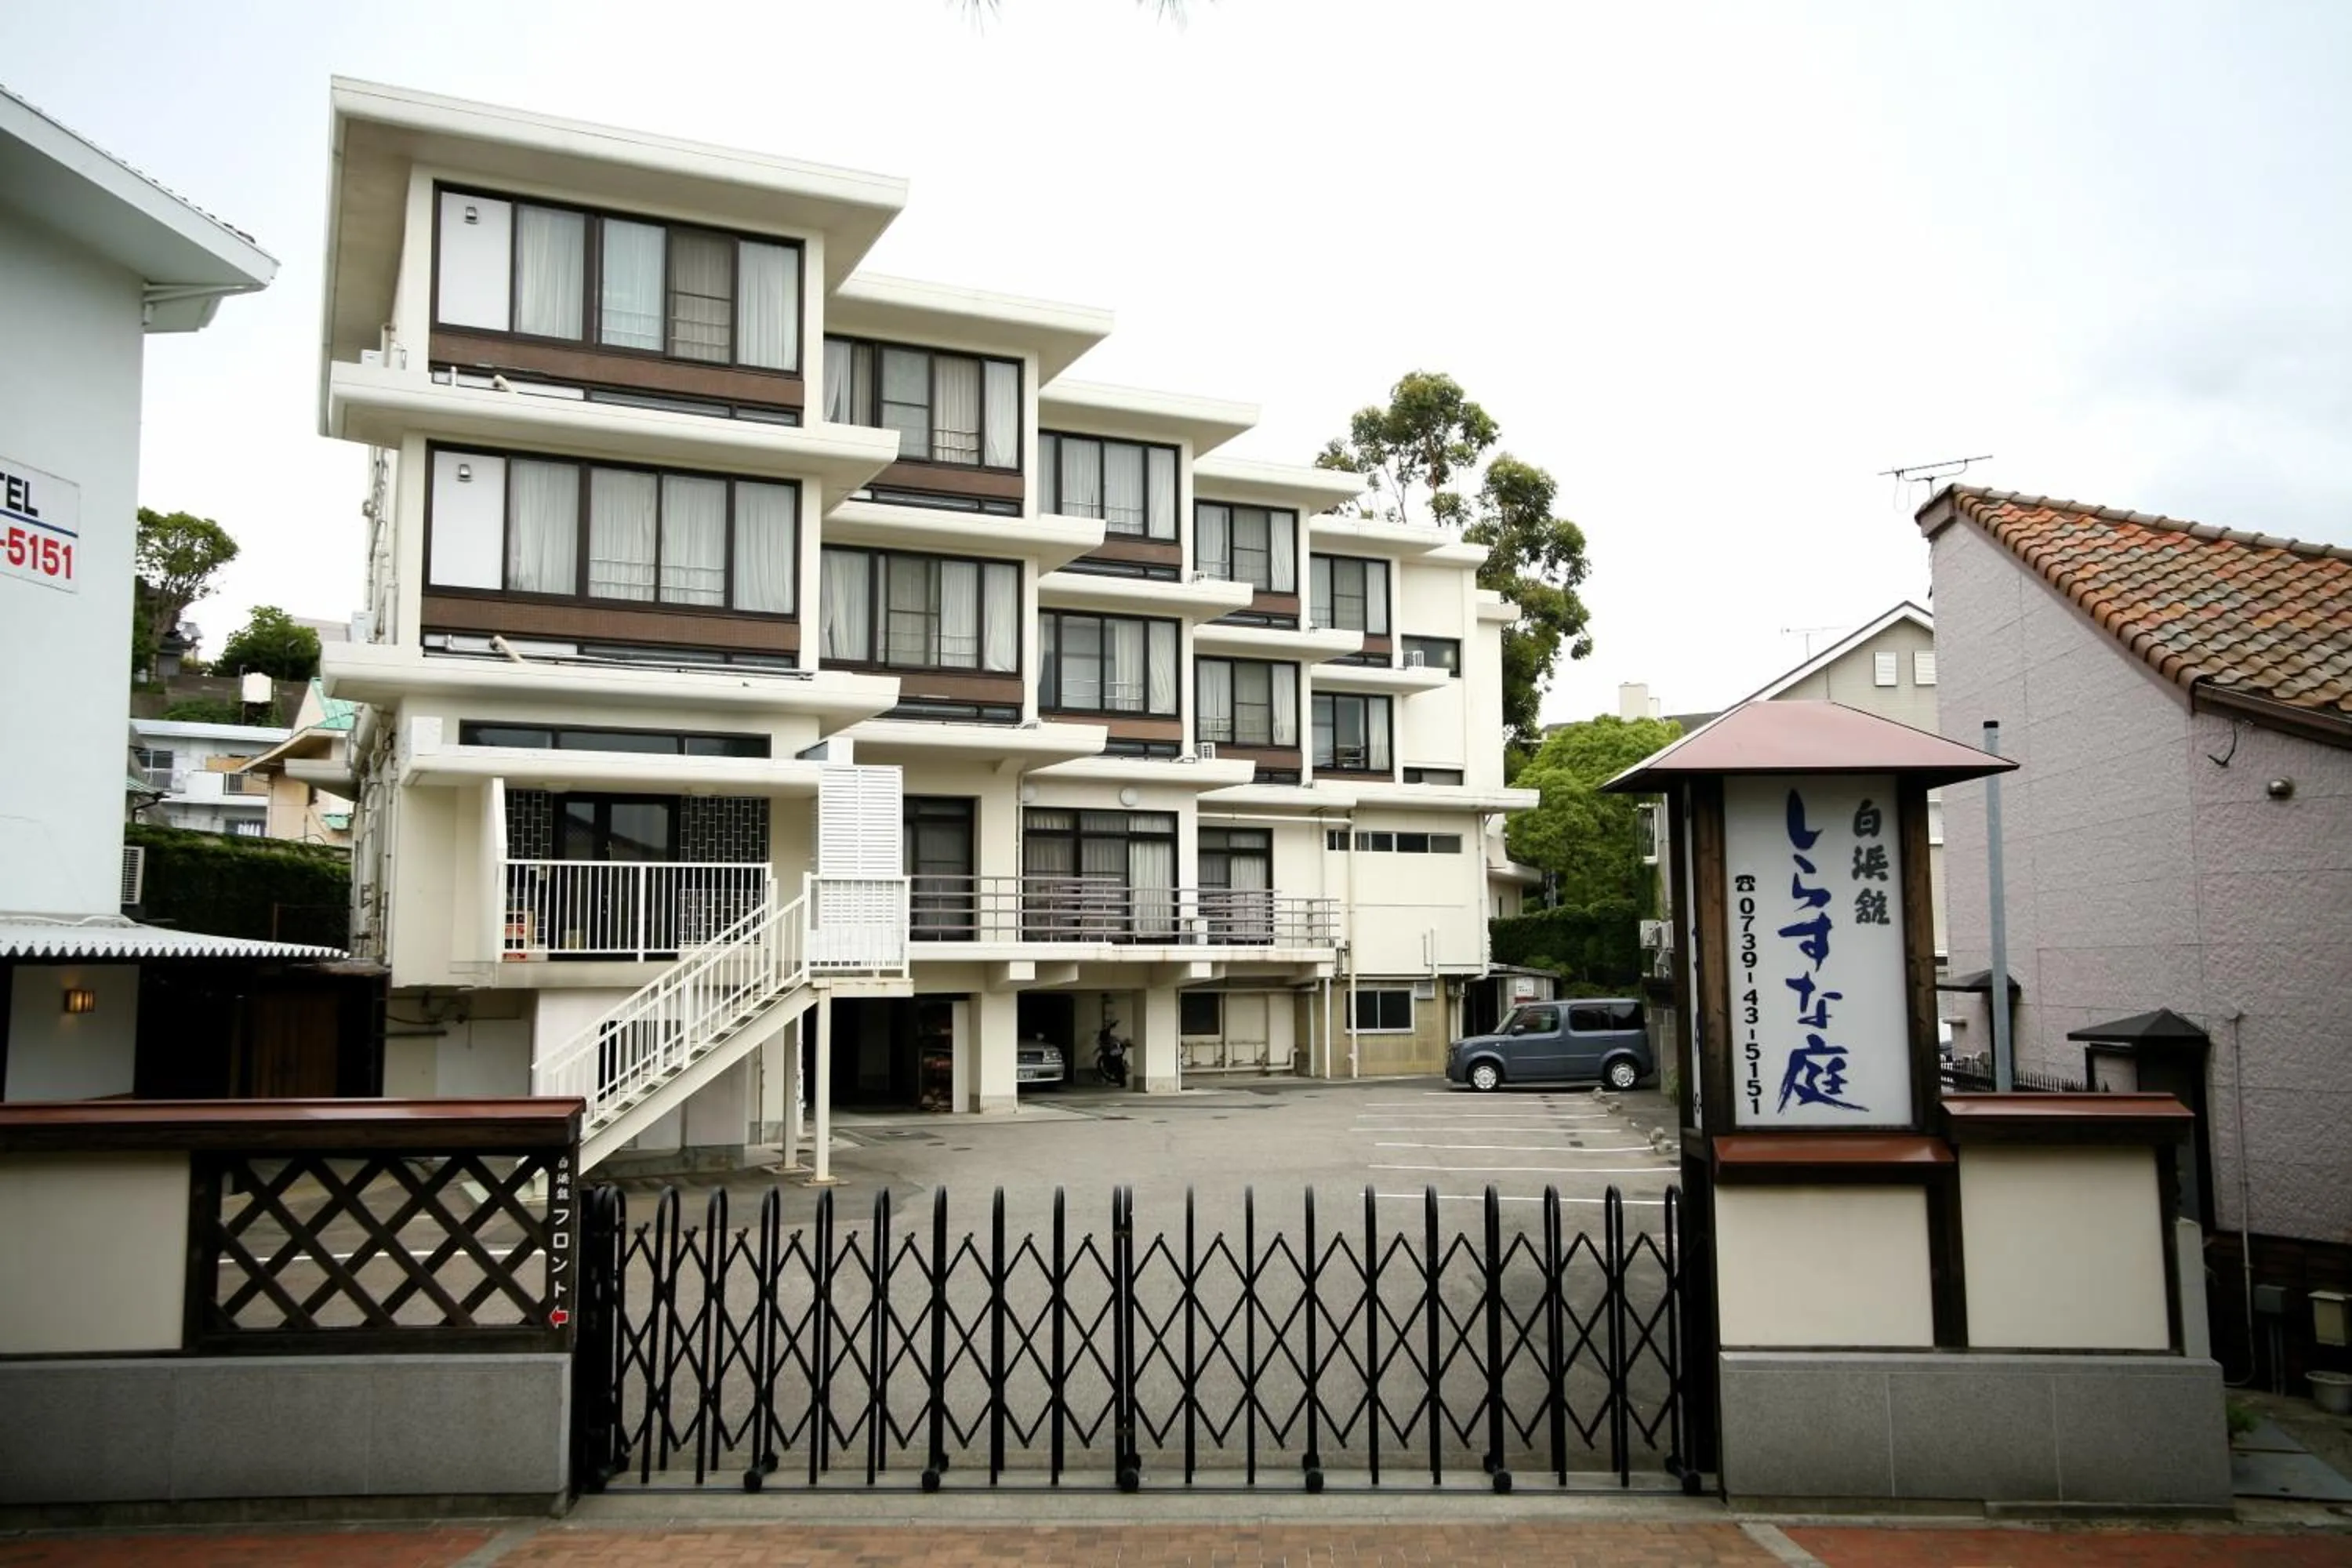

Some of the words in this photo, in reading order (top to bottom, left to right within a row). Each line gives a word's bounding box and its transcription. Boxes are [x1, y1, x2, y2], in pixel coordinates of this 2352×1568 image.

[0, 472, 38, 517] EL
[1778, 788, 1870, 1113] しらすな庭
[552, 1209, 569, 1298] フロント
